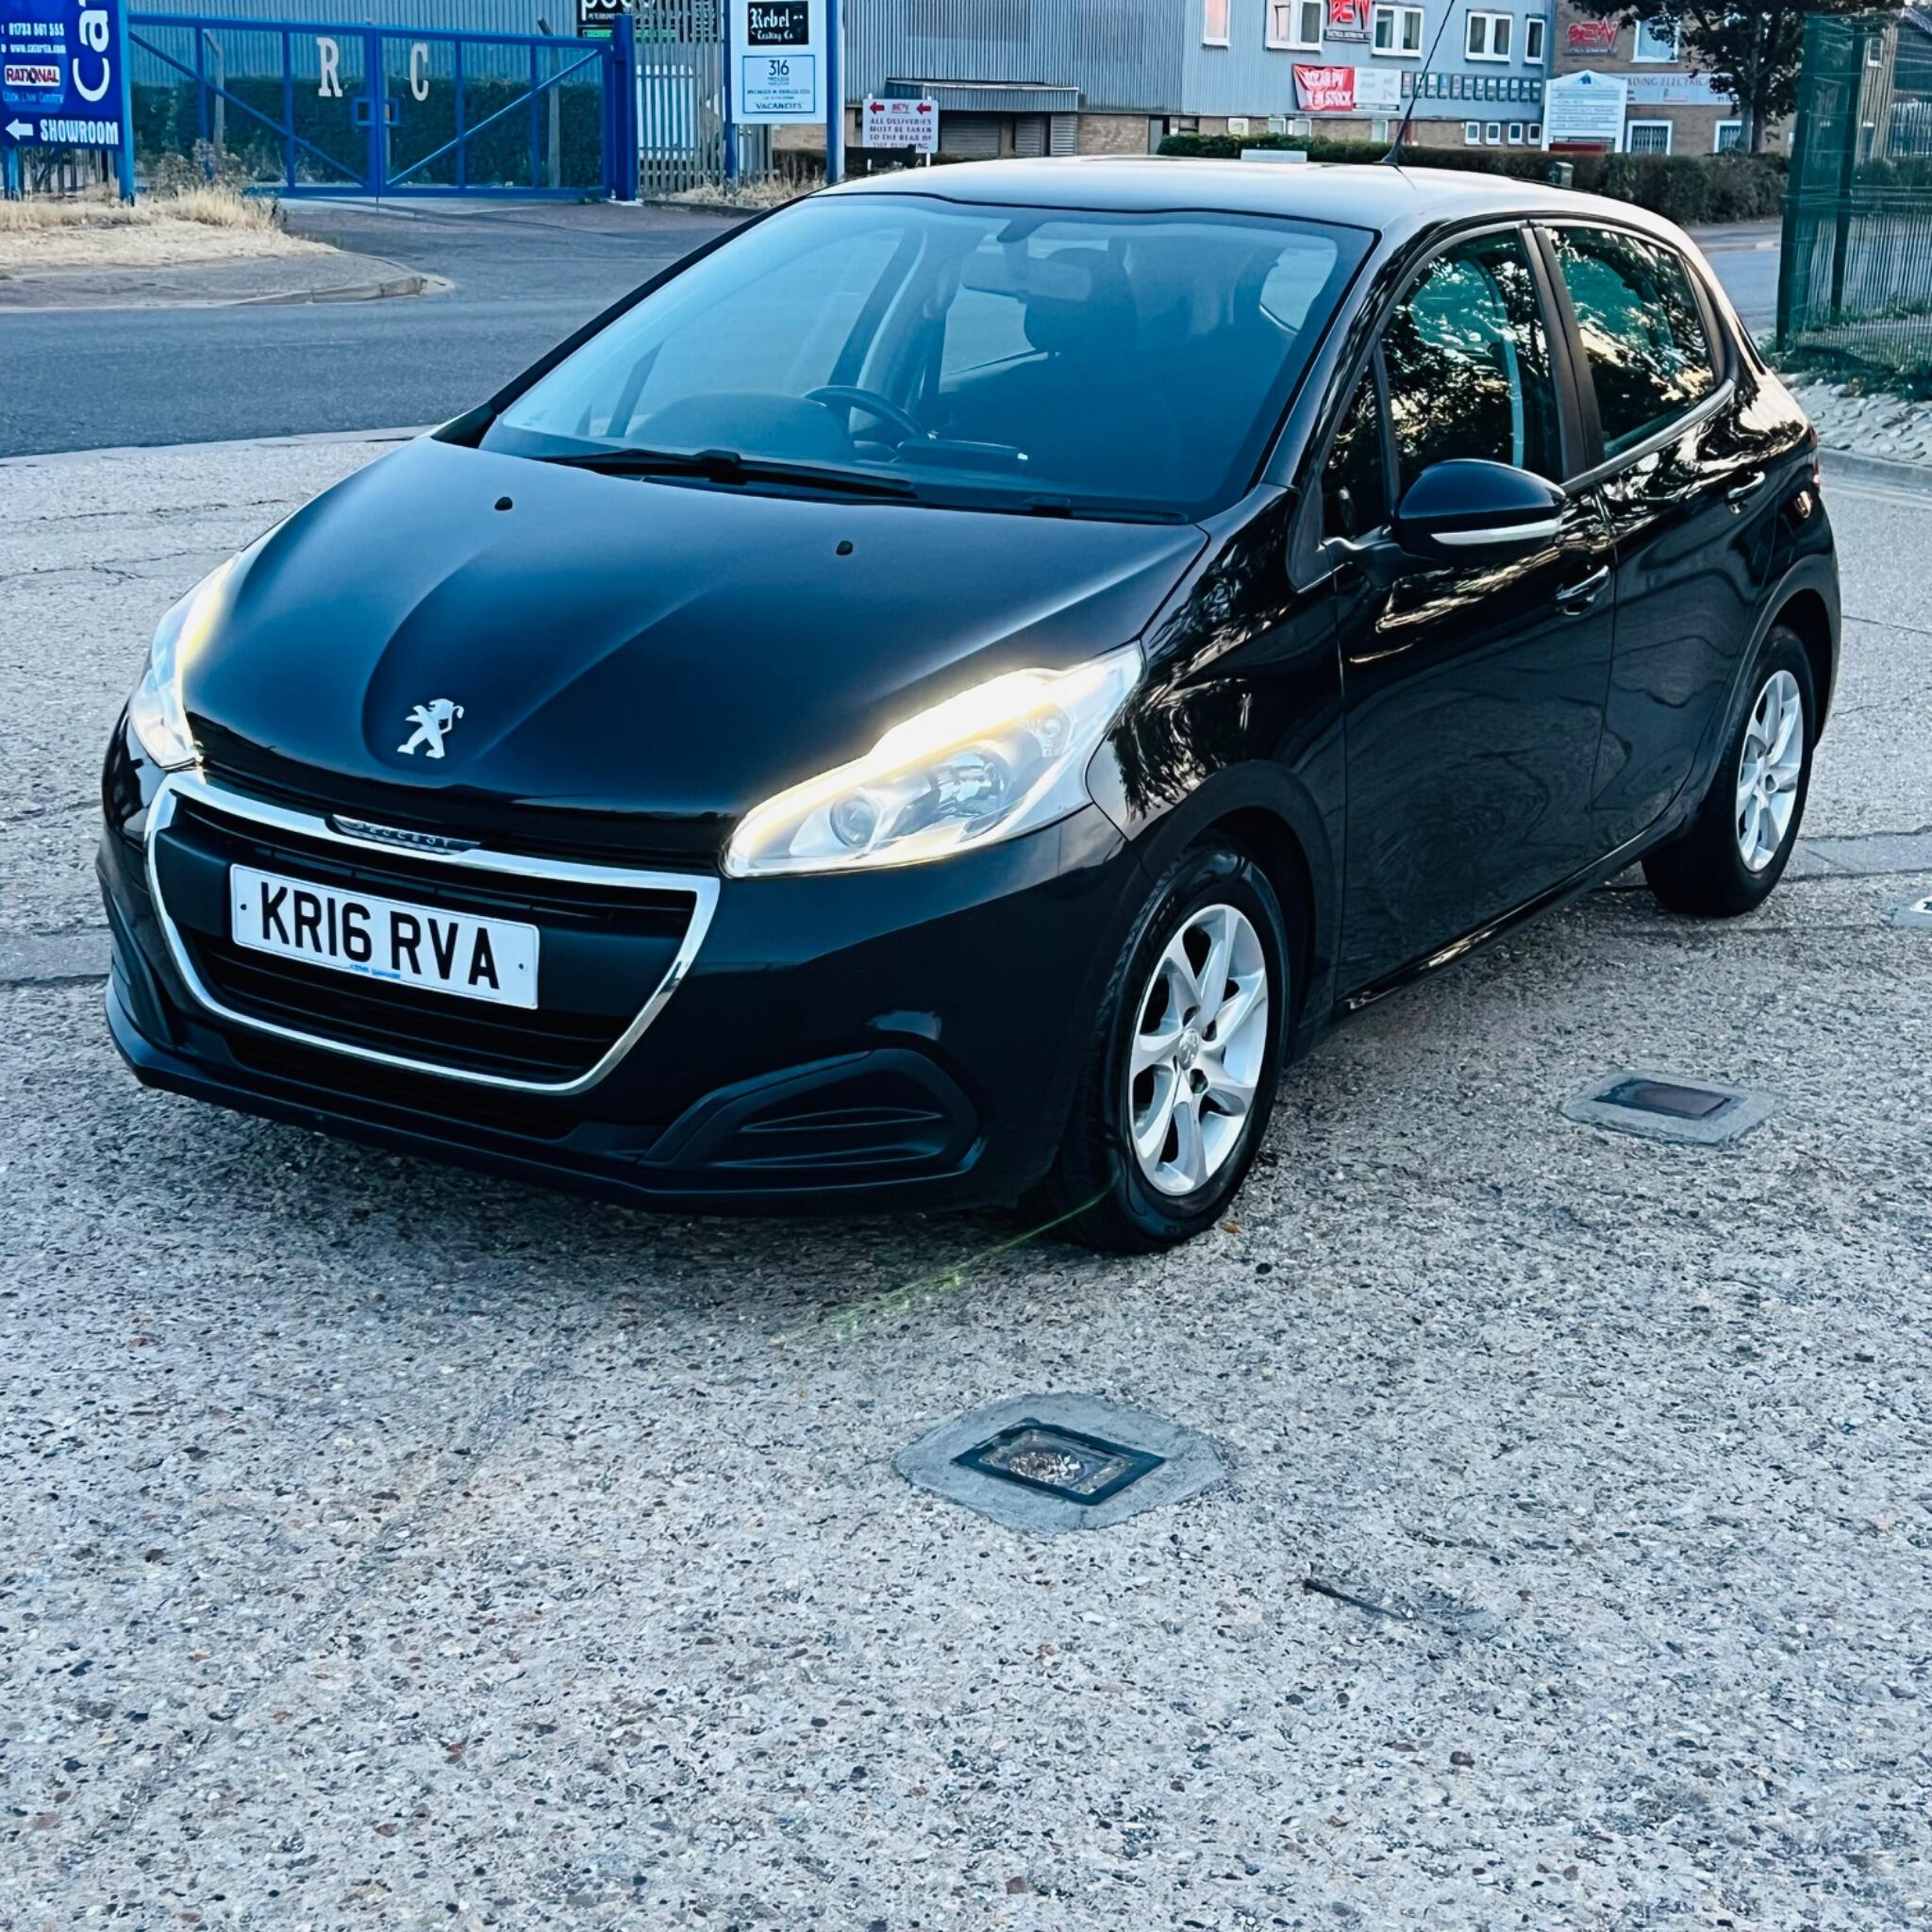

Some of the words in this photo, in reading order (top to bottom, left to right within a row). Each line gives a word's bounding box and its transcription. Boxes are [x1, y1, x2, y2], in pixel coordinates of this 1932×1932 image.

[750, 8, 790, 28] Rebel
[6, 67, 59, 84] RATIONAL
[316, 36, 343, 97] R
[409, 42, 429, 102] C
[768, 59, 790, 76] 316
[40, 119, 119, 145] SHOWROOM
[260, 881, 373, 963] KR16
[389, 910, 500, 991] RVA
